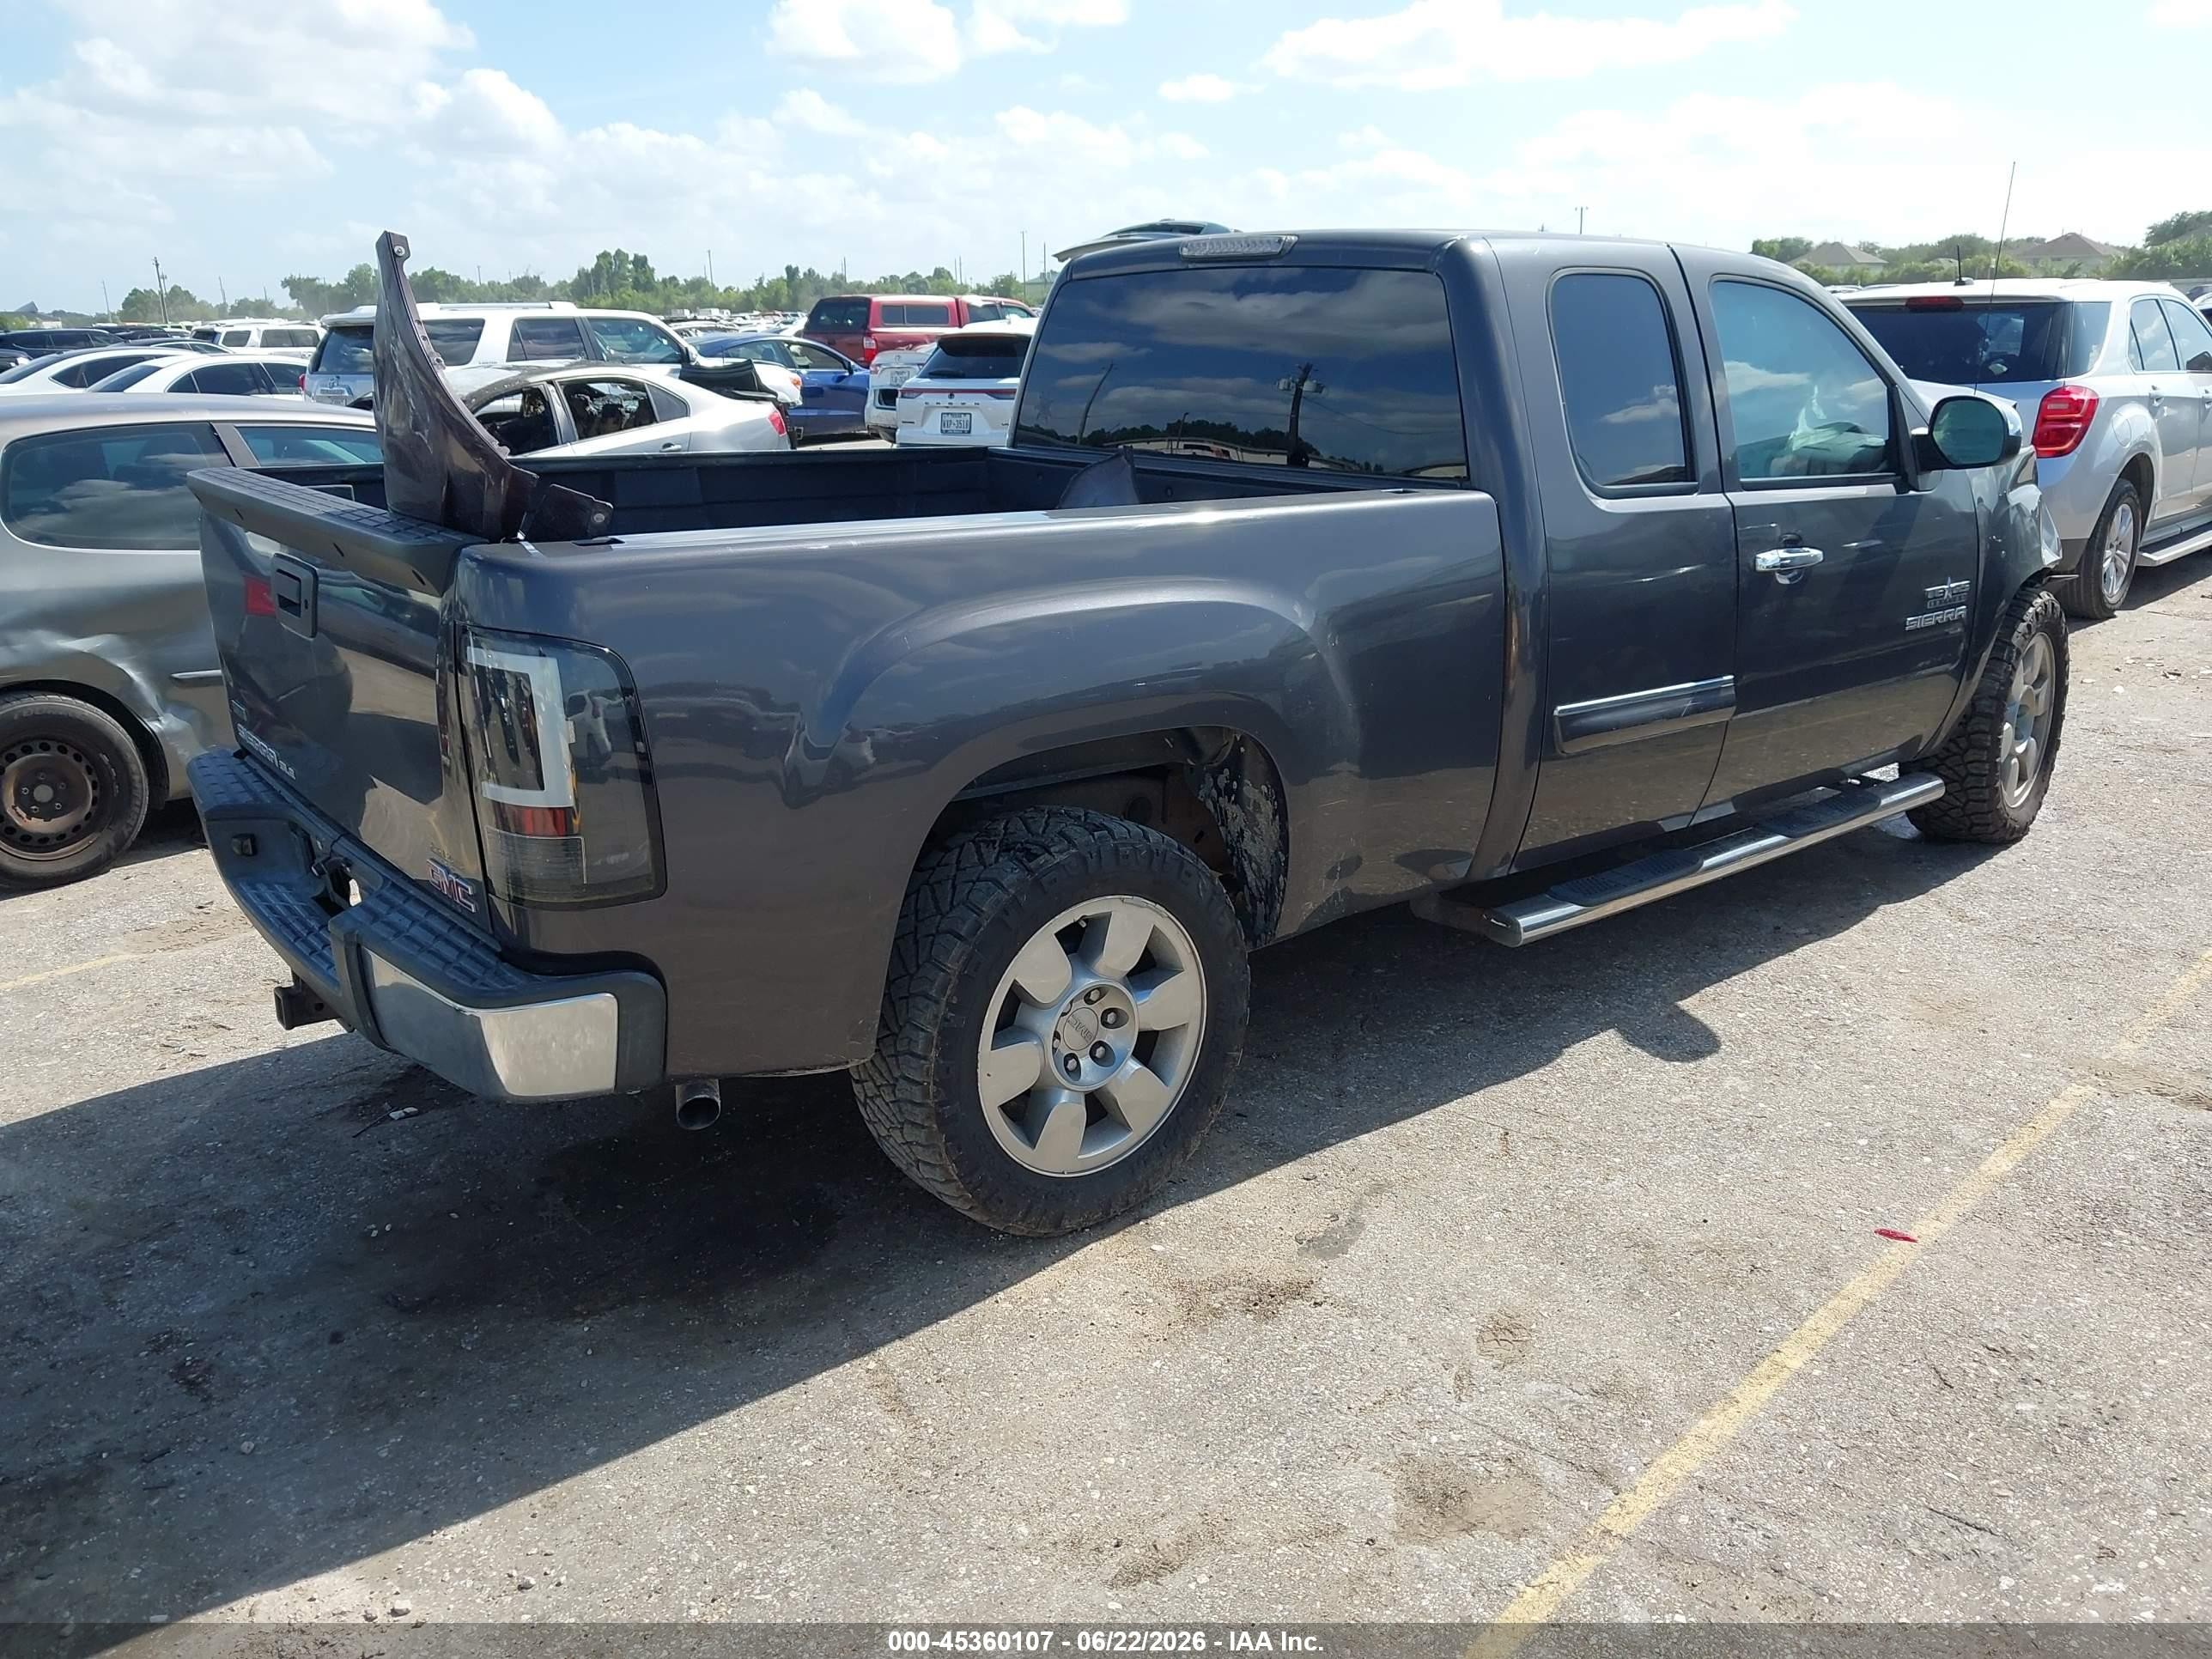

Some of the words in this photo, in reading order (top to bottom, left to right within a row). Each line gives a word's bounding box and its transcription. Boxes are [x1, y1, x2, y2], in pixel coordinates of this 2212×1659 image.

[1905, 605, 1966, 631] SIERRA
[236, 722, 280, 768] SIERRA
[426, 859, 477, 913] GMC
